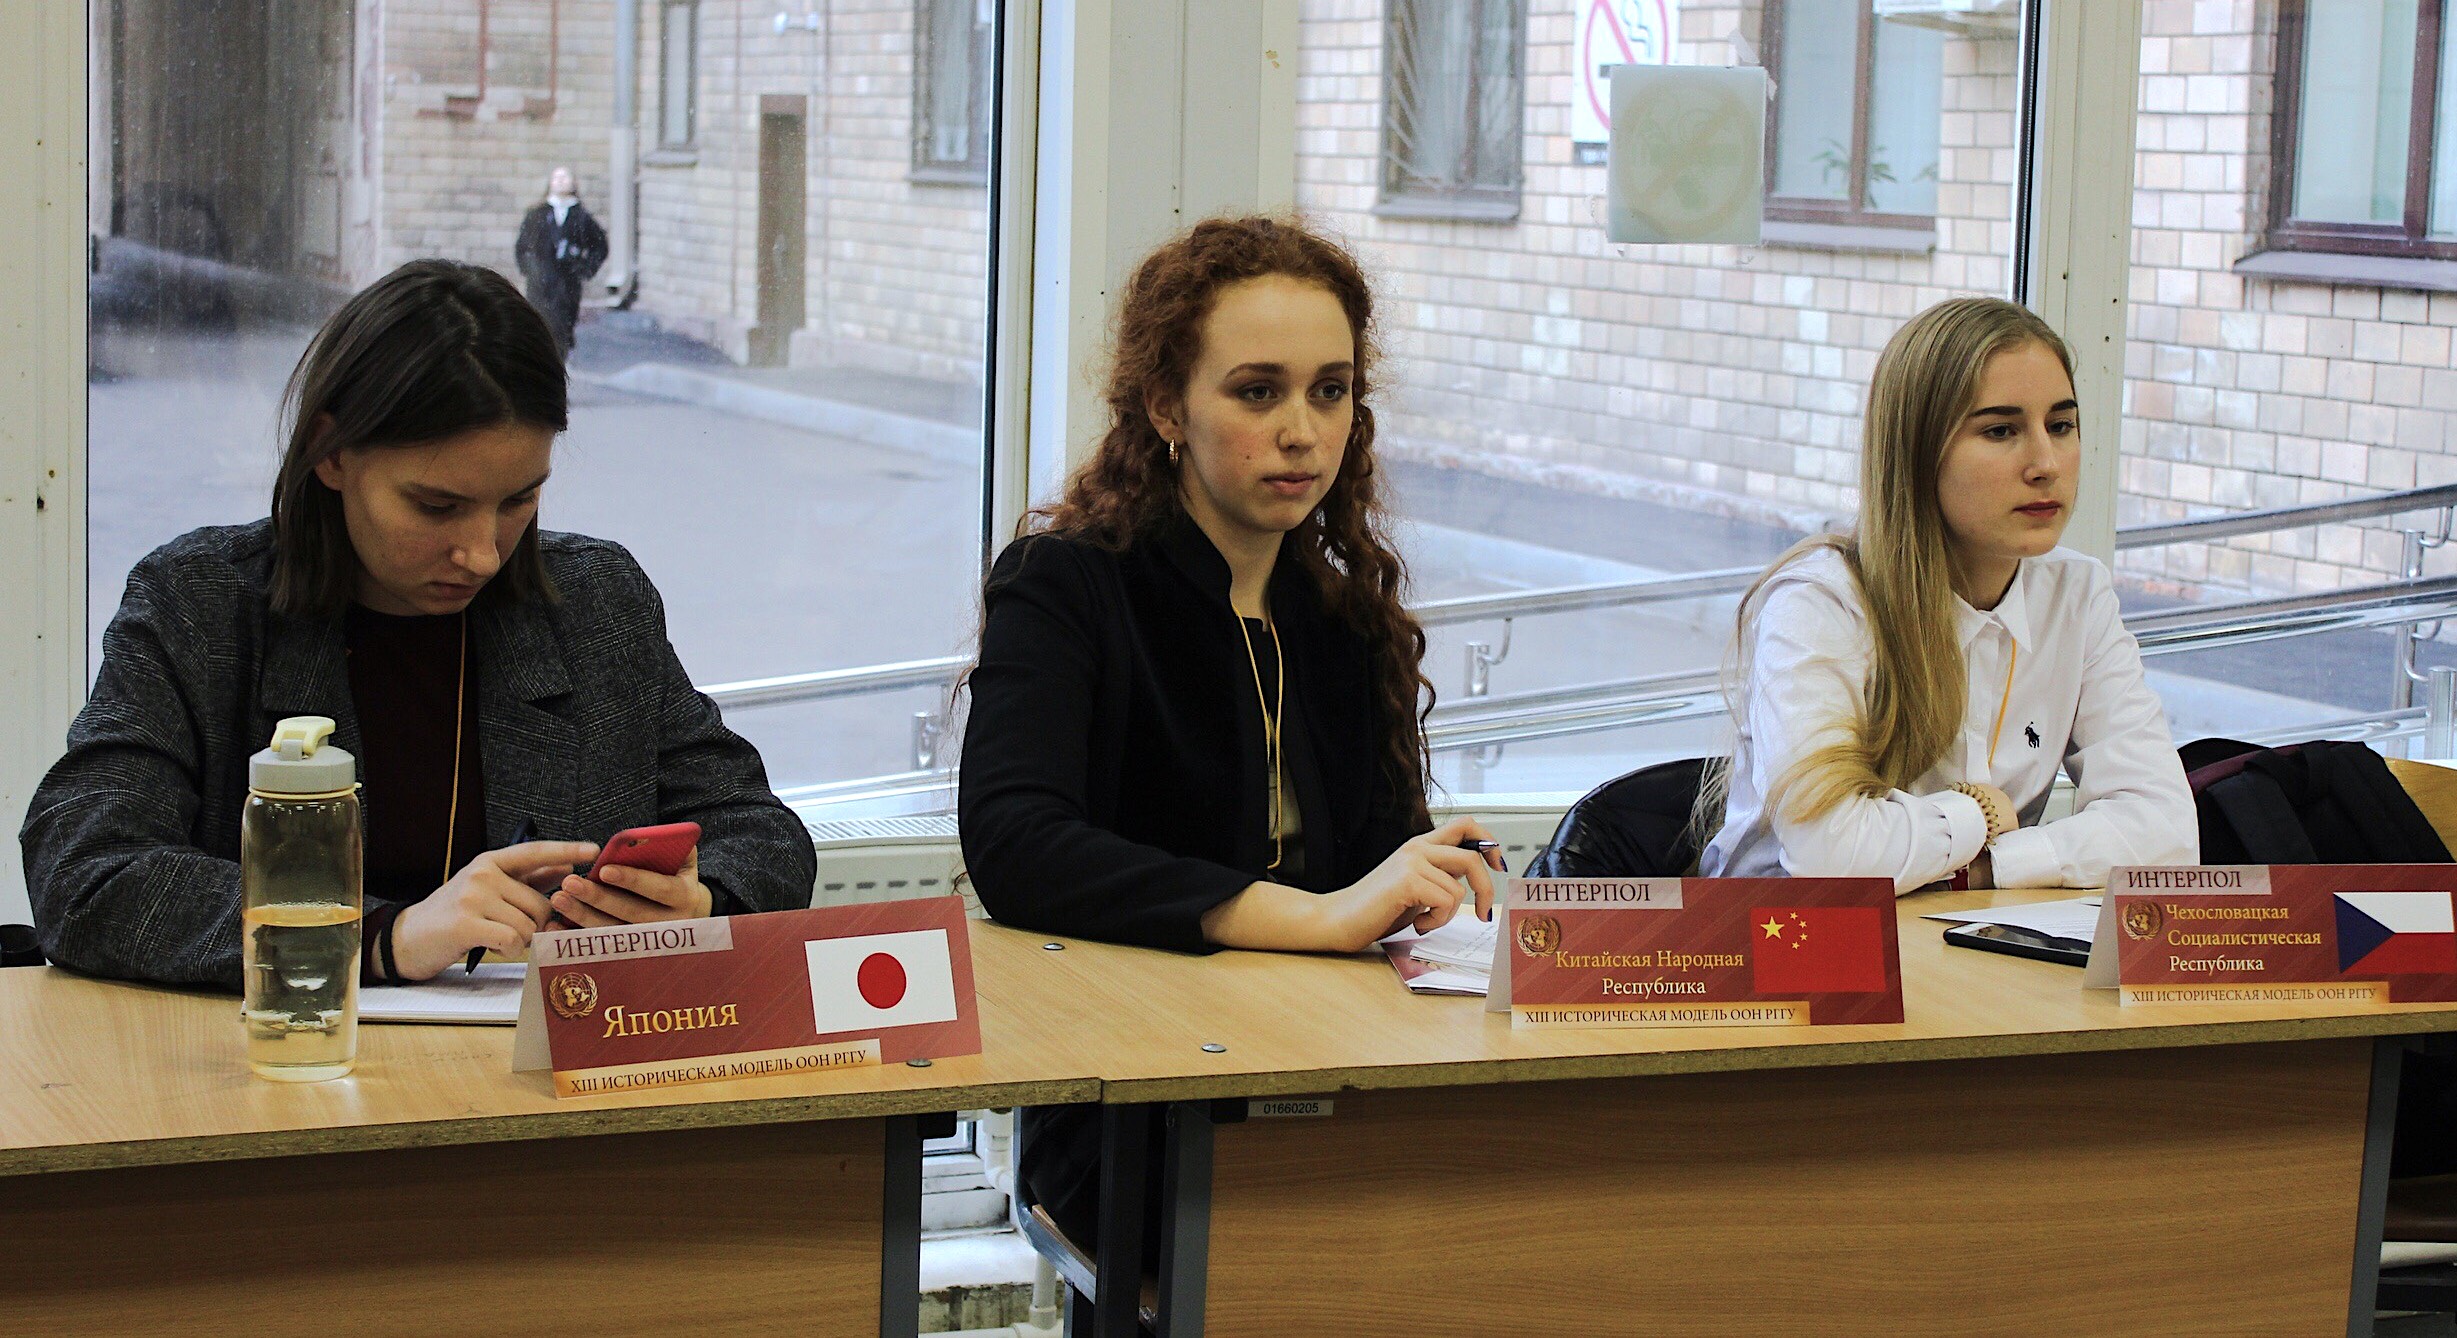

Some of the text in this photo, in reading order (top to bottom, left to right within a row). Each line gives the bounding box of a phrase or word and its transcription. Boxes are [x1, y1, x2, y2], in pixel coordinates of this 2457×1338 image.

[2127, 870, 2242, 889] ИНТЕРПОЛ
[1525, 882, 1651, 902] ИНТЕРПОЛ
[2165, 904, 2289, 922] Чехословацкая
[554, 927, 697, 960] ИНТЕРПОЛ
[2167, 929, 2321, 948] Социалистическая
[1555, 950, 1744, 972] Китайская Народная
[2169, 954, 2265, 976] Республика
[1602, 977, 1707, 1000] Республика
[2157, 989, 2260, 1002] ИСТОРИЧЕСКАЯ
[2263, 989, 2314, 1001] МОДЕЛЬ
[2317, 988, 2345, 999] ООН
[2349, 988, 2376, 999] РГГУ
[602, 1001, 740, 1039] Япония
[1553, 1010, 1666, 1022] ИСТОРИЧЕСКАЯ
[1671, 1009, 1727, 1022] МОДЕЛЬ
[1730, 1008, 1761, 1020] ООН
[1765, 1008, 1795, 1020] РГГУ
[602, 1064, 727, 1090] ИСТОРИЧЕСКАЯ
[731, 1058, 793, 1076] МОДЕЛЬ
[795, 1053, 830, 1069] ООН
[834, 1050, 866, 1065] РГГУ
[1263, 1102, 1319, 1114] 01660205
